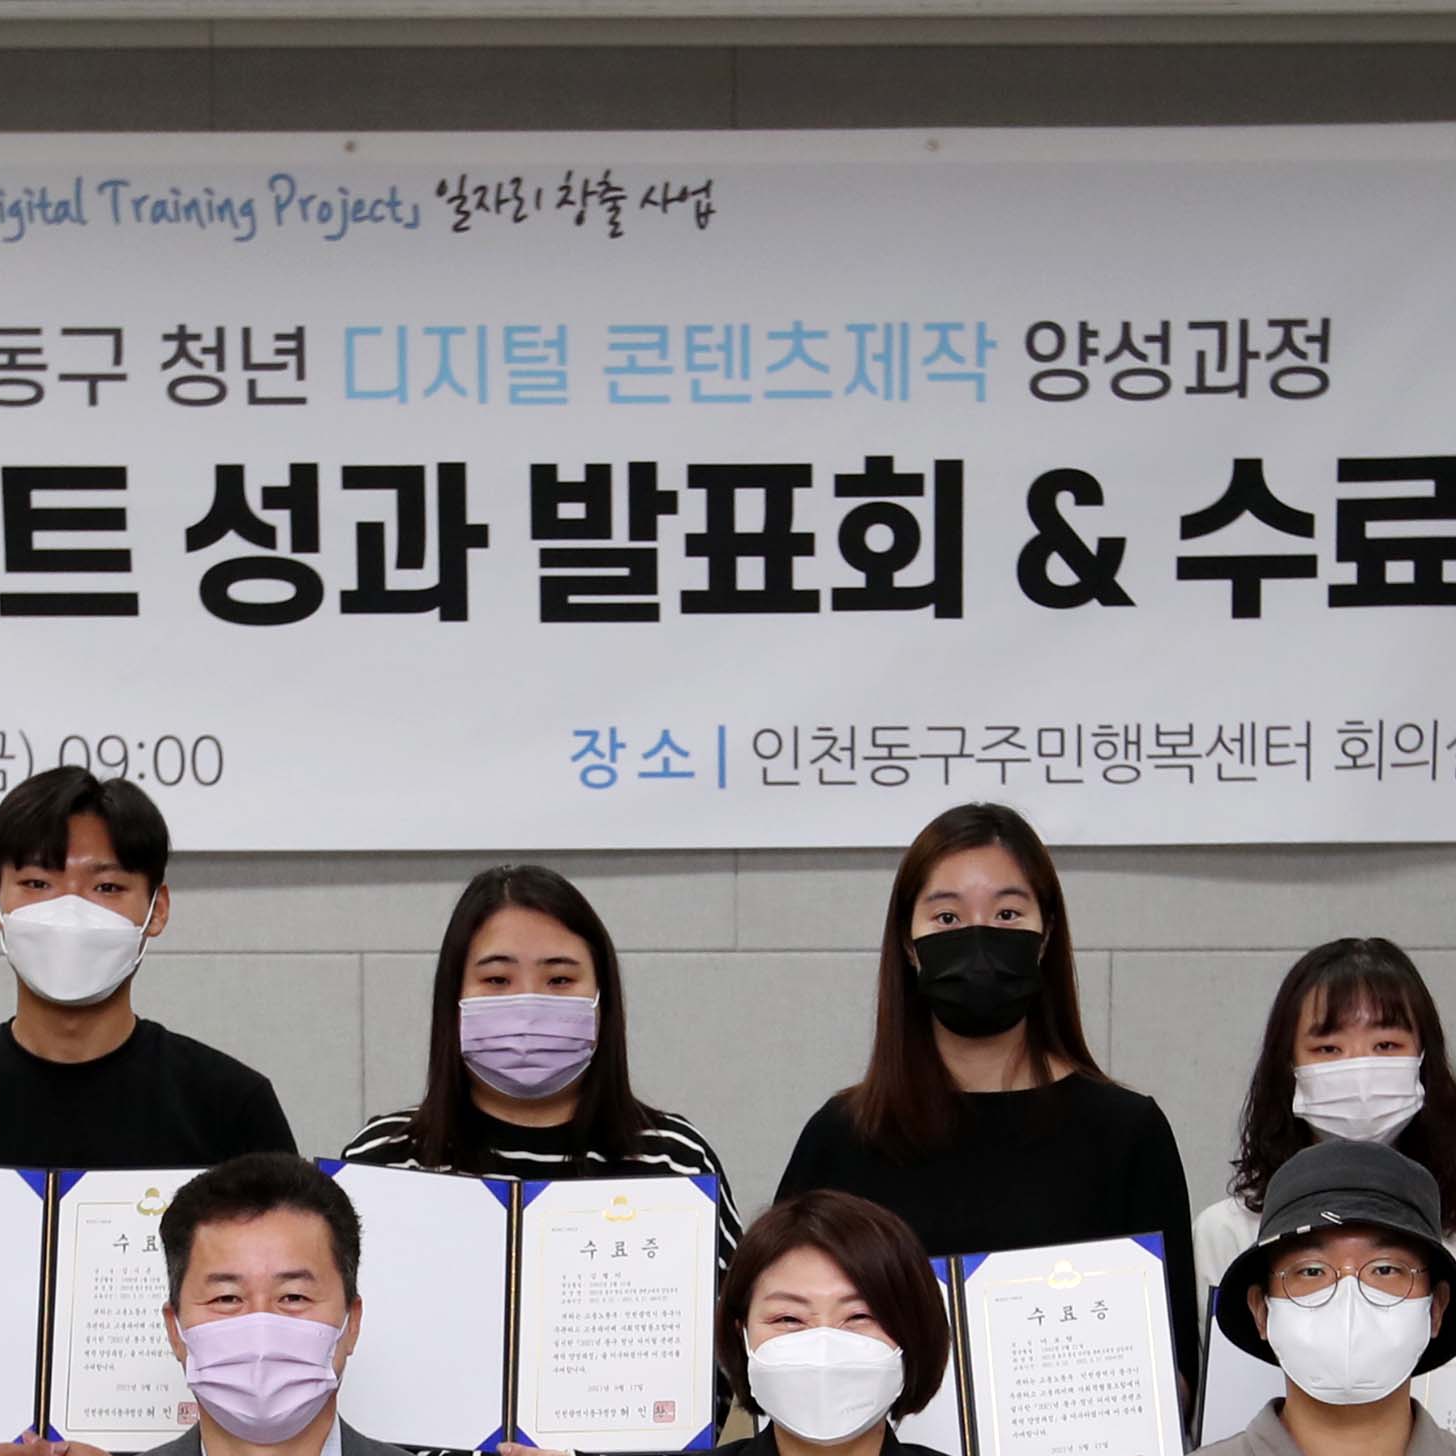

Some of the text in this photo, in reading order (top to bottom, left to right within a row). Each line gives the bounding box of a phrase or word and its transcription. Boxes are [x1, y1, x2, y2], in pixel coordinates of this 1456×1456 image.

[96, 177, 257, 243] Training
[433, 173, 545, 234] 일자리
[554, 167, 628, 240] 창출
[638, 177, 718, 231] 사업
[159, 322, 309, 408] 청년
[343, 322, 570, 407] 디지털
[602, 319, 999, 405] 콘텐츠제작
[1023, 316, 1334, 403] 양성과정
[183, 460, 491, 628] 성과
[528, 454, 966, 624] 발표회
[1015, 466, 1138, 611] &
[59, 734, 224, 786] 09:00
[750, 719, 1314, 788] 인천동구주민행복센터
